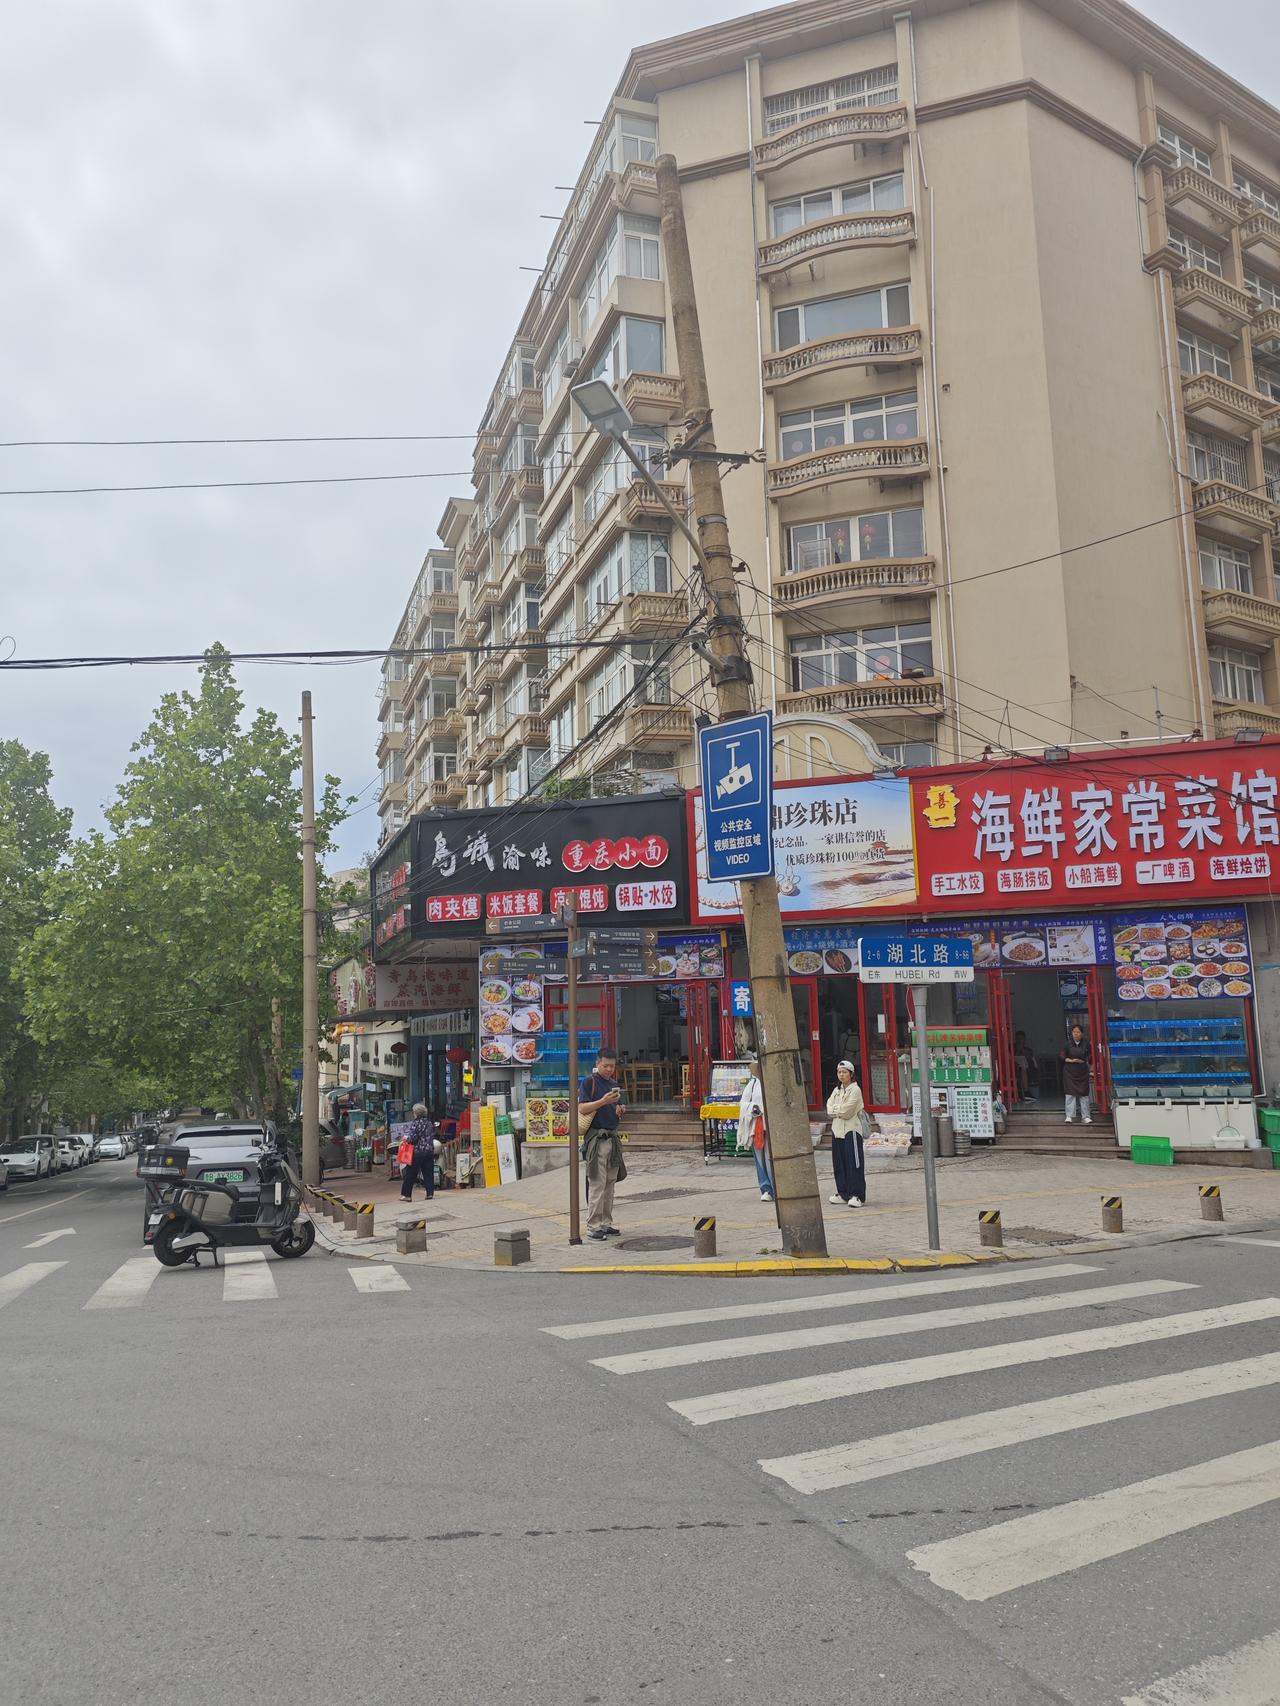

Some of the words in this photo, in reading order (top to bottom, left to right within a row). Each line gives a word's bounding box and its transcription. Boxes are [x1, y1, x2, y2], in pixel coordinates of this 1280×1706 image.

[720, 817, 753, 833] 公共安全
[970, 768, 1280, 862] 海鲜家常菜馆
[713, 832, 763, 852] 视频监控区域
[815, 829, 886, 846] 一家讲信誉的店
[567, 840, 662, 868] 重庆小面
[725, 853, 750, 865] VIDEO
[1068, 864, 1118, 885] 小船海鲜
[1138, 860, 1191, 881] 一厂啤酒
[1212, 856, 1268, 877] 海鲜烩饼
[933, 874, 981, 892] 手工水饺
[1000, 869, 1050, 888] 海肠捞饭
[428, 896, 479, 920] 肉夹馍
[489, 892, 539, 915] 米饭套餐
[554, 887, 605, 909] 凉馄饨
[867, 950, 881, 960] 2-6
[886, 943, 950, 964] 湖北路
[895, 970, 923, 979] HUBEI
[928, 970, 941, 979] Rd
[734, 986, 751, 1012] 寄
